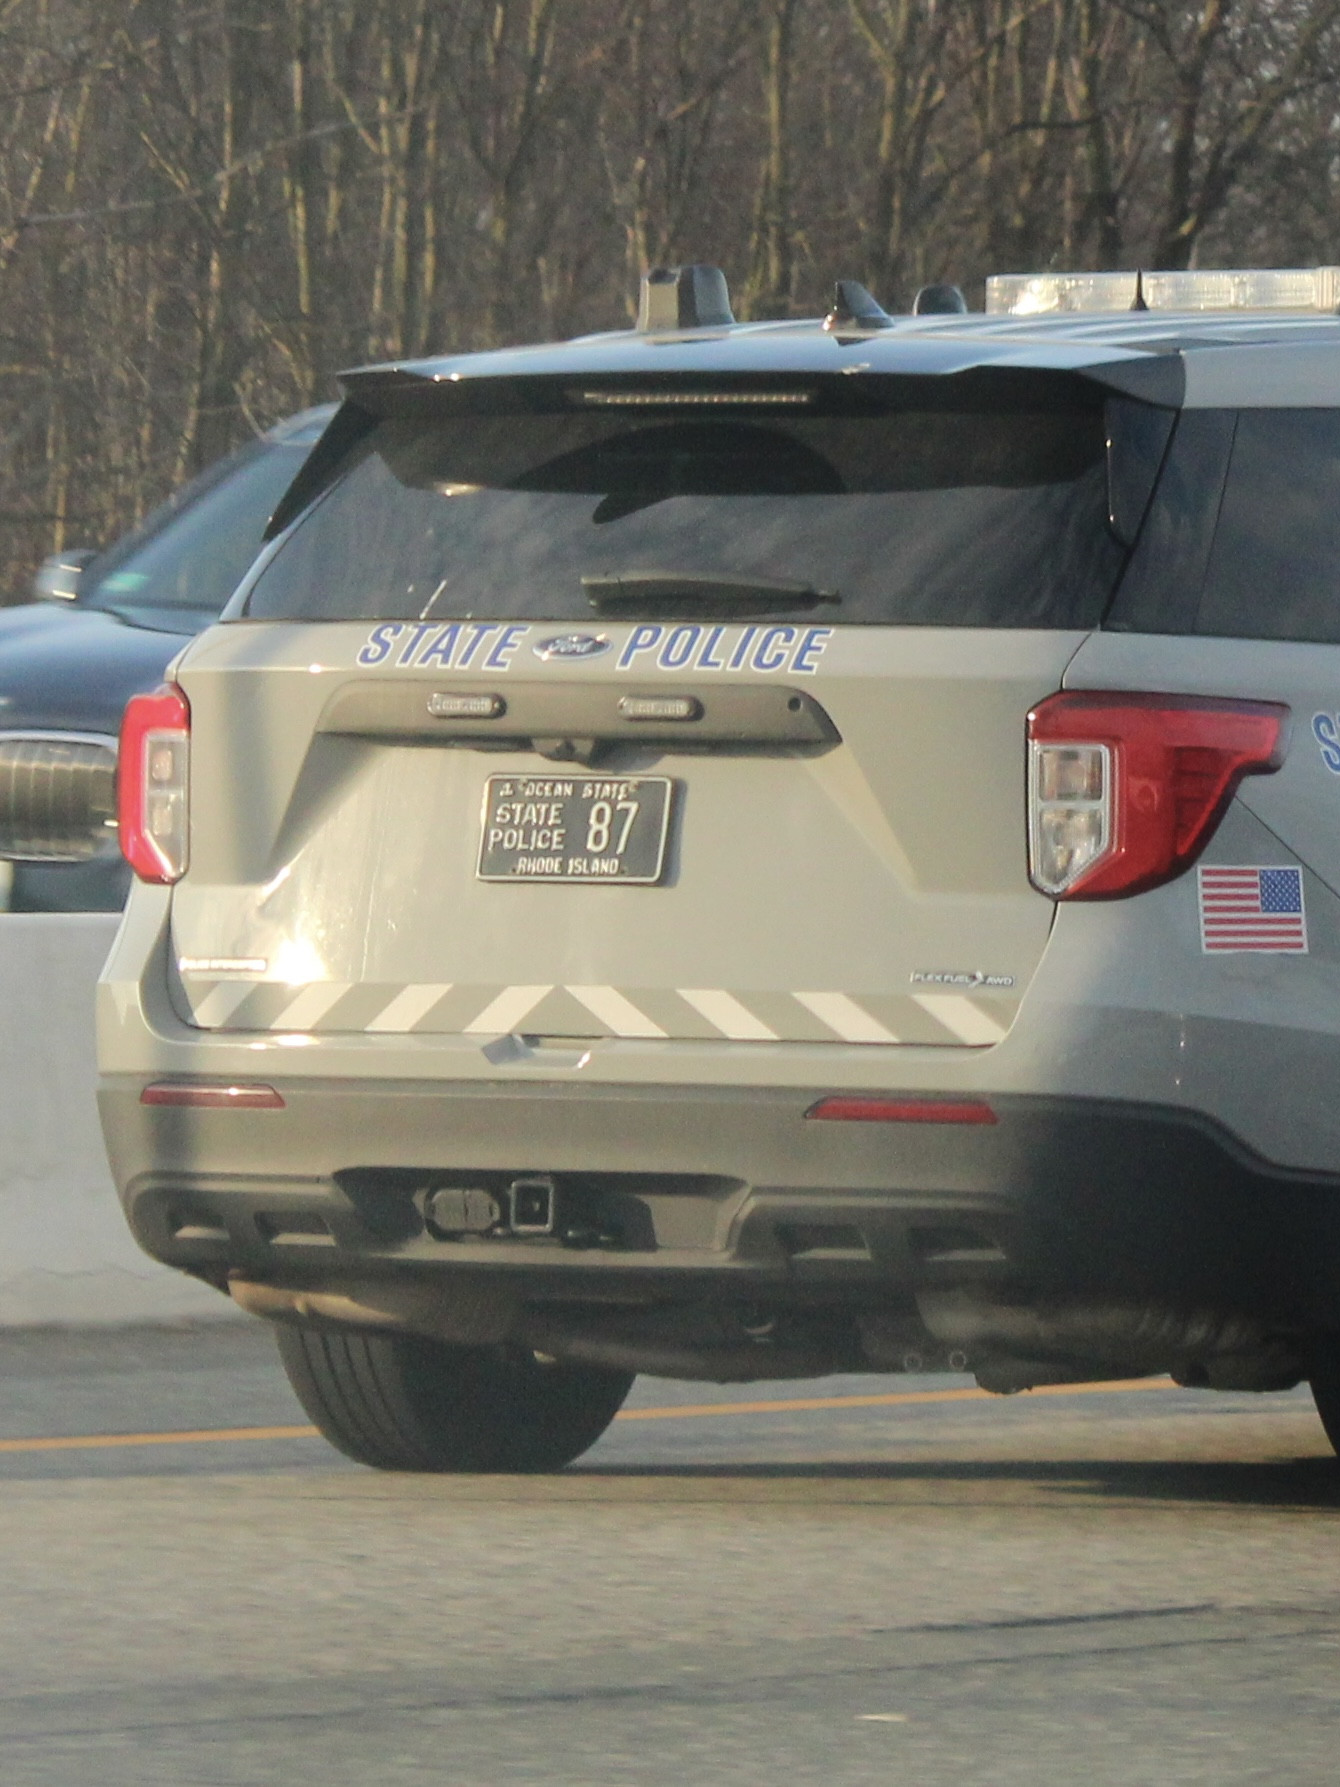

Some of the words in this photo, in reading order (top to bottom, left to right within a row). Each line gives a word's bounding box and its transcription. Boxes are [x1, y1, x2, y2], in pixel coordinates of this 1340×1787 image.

[356, 623, 533, 672] STATE
[615, 623, 837, 676] POLICE
[524, 781, 574, 798] OCEAN
[582, 783, 629, 801] STATE
[495, 803, 564, 826] STATE
[586, 801, 640, 855] 87
[488, 828, 567, 853] POLICE
[516, 856, 564, 875] RHODE
[567, 857, 620, 876] ISLAND
